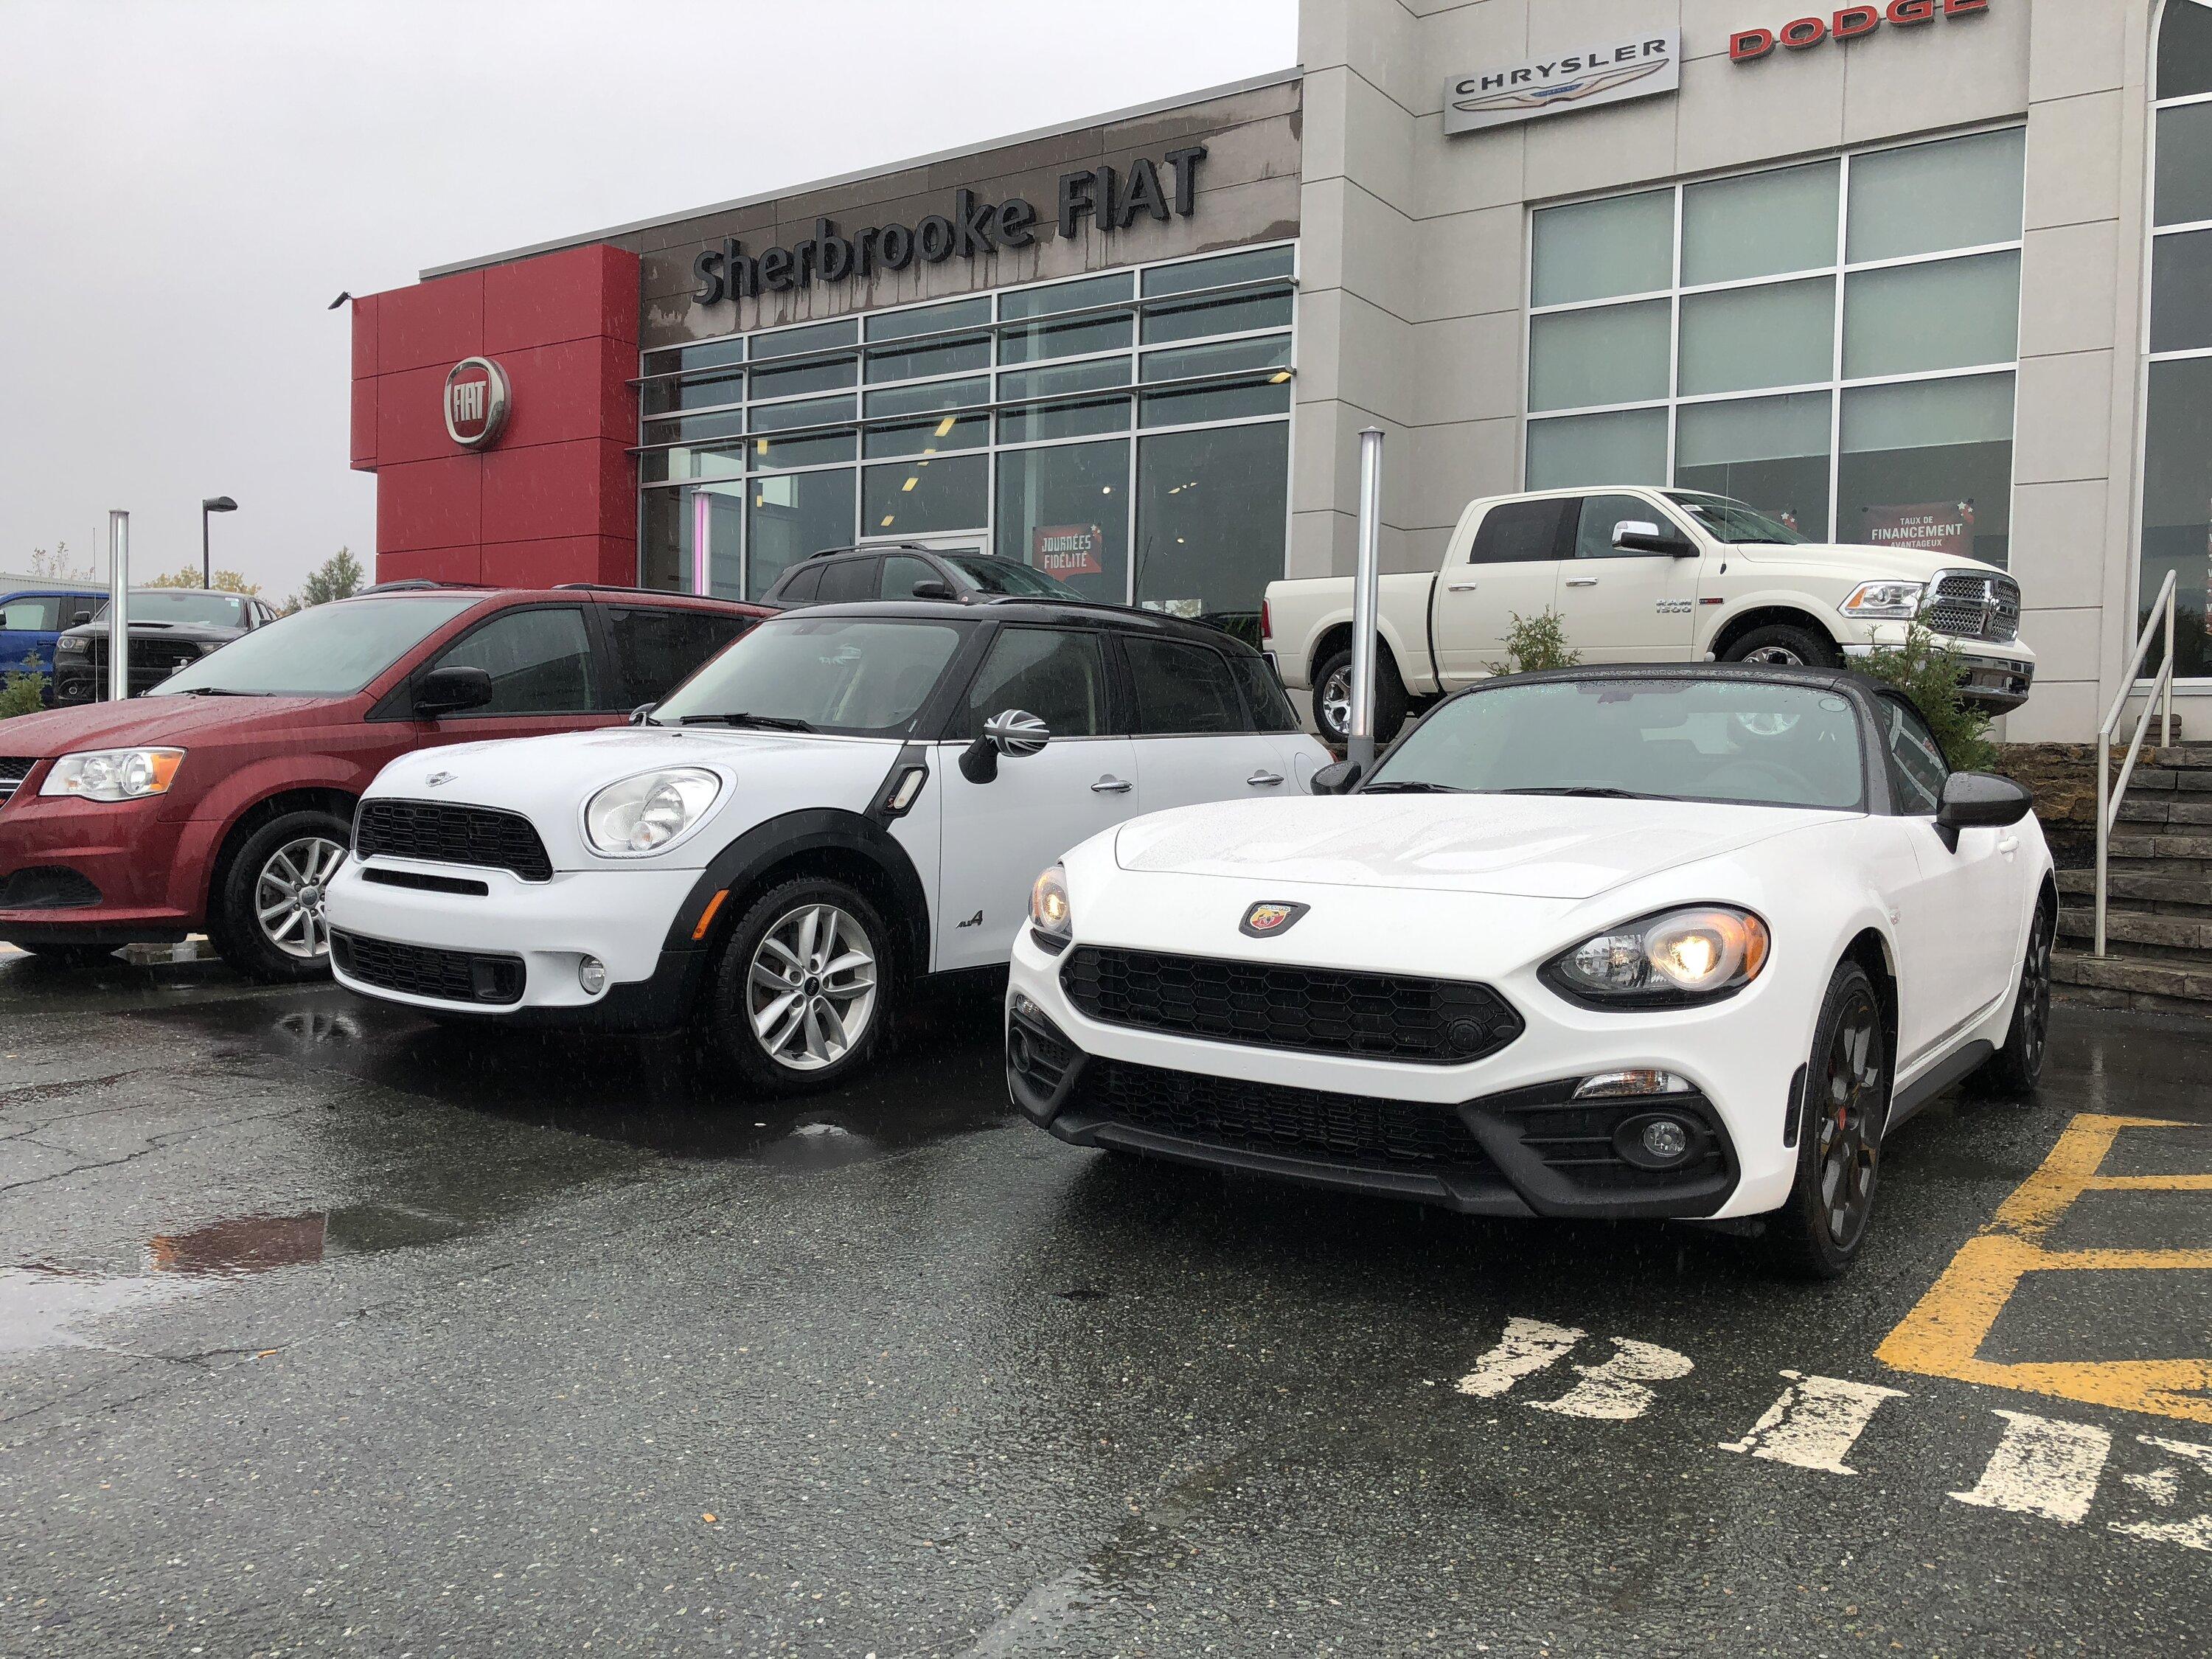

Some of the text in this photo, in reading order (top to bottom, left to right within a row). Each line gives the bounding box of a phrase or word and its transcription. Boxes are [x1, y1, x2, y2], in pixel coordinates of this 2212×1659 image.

[1455, 39, 1666, 95] CHRYSLER
[692, 146, 1207, 305] Sherbrooke FIAT
[453, 380, 487, 422] FIAT
[1899, 517, 1921, 525] TAUX
[1871, 524, 1963, 540] FINANCEMENT
[1041, 533, 1091, 552] JOURNÉES
[1891, 539, 1942, 548] AVANTAGEUX
[1044, 550, 1088, 569] FIDÉLITÉ
